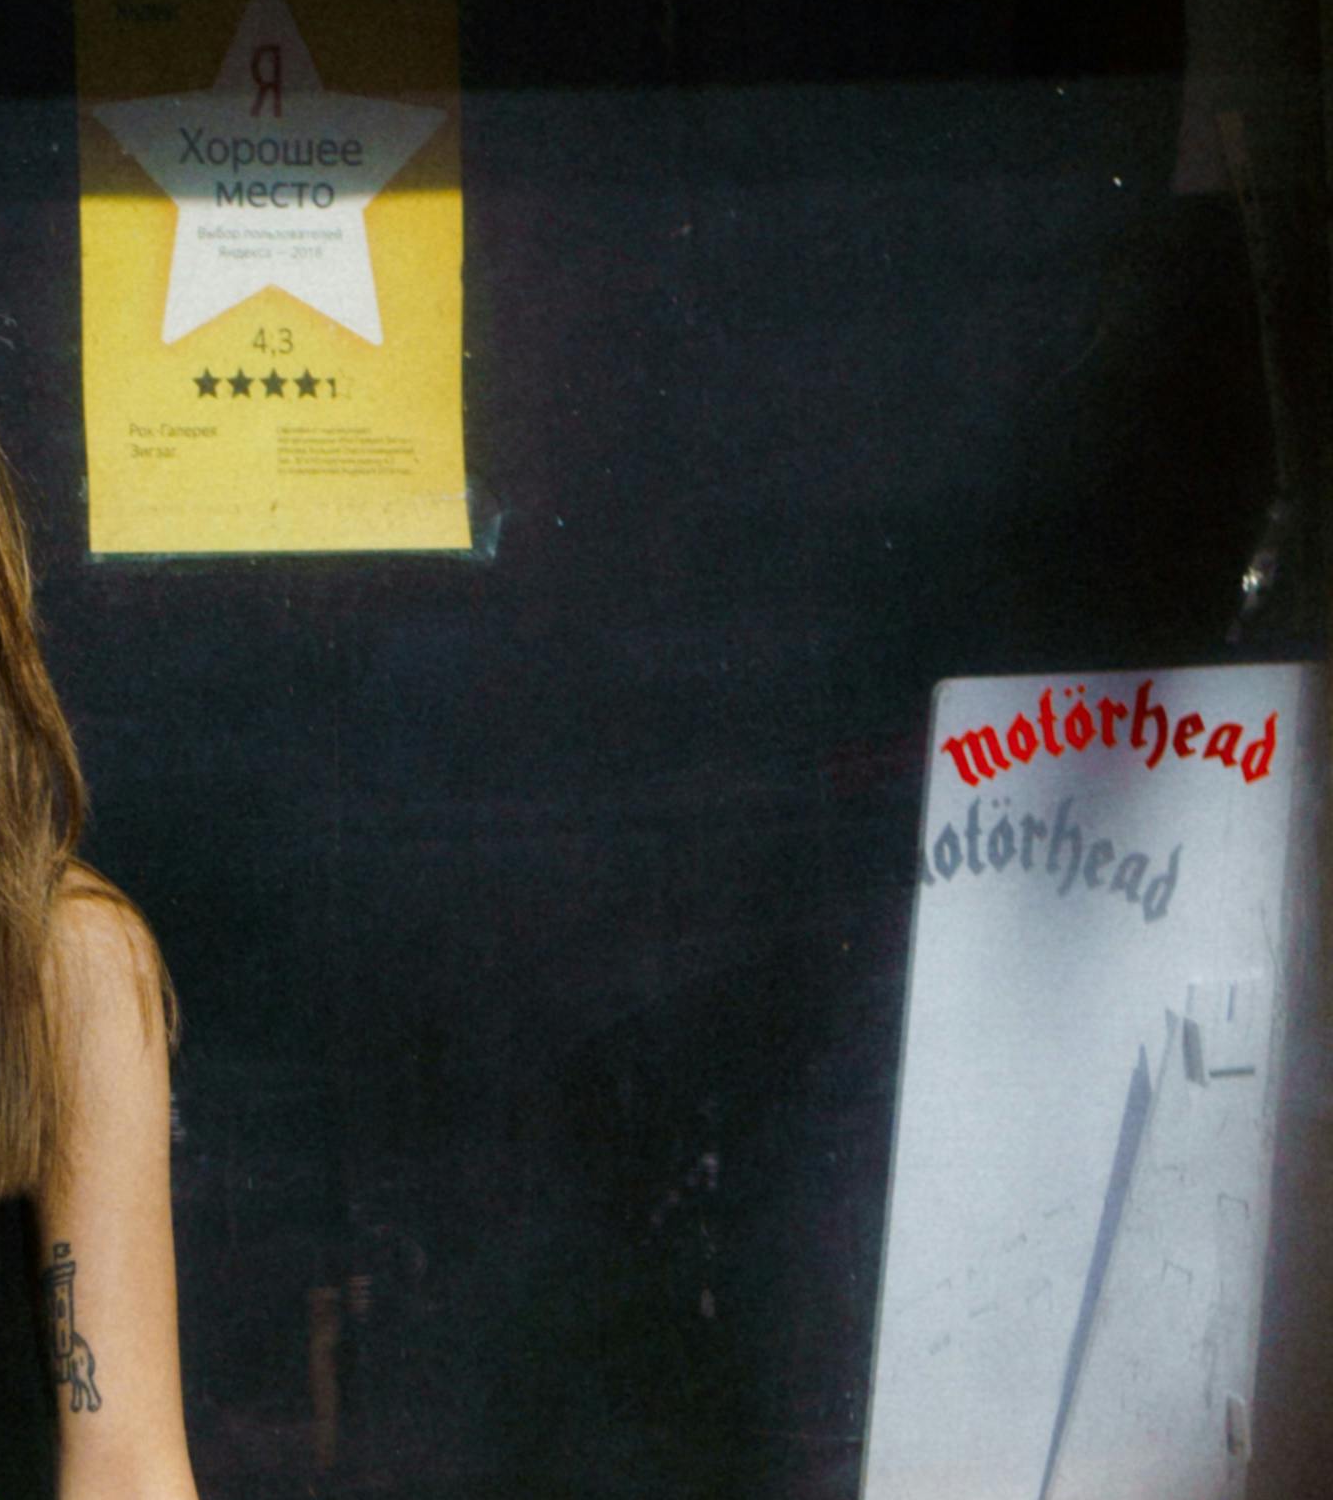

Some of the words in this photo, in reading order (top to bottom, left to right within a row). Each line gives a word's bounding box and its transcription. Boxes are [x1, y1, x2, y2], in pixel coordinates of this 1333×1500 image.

[250, 43, 282, 118] Я
[178, 126, 364, 174] Хорошее
[215, 180, 336, 209] место
[252, 326, 294, 357] 4,3
[940, 679, 1279, 788] motörhead
